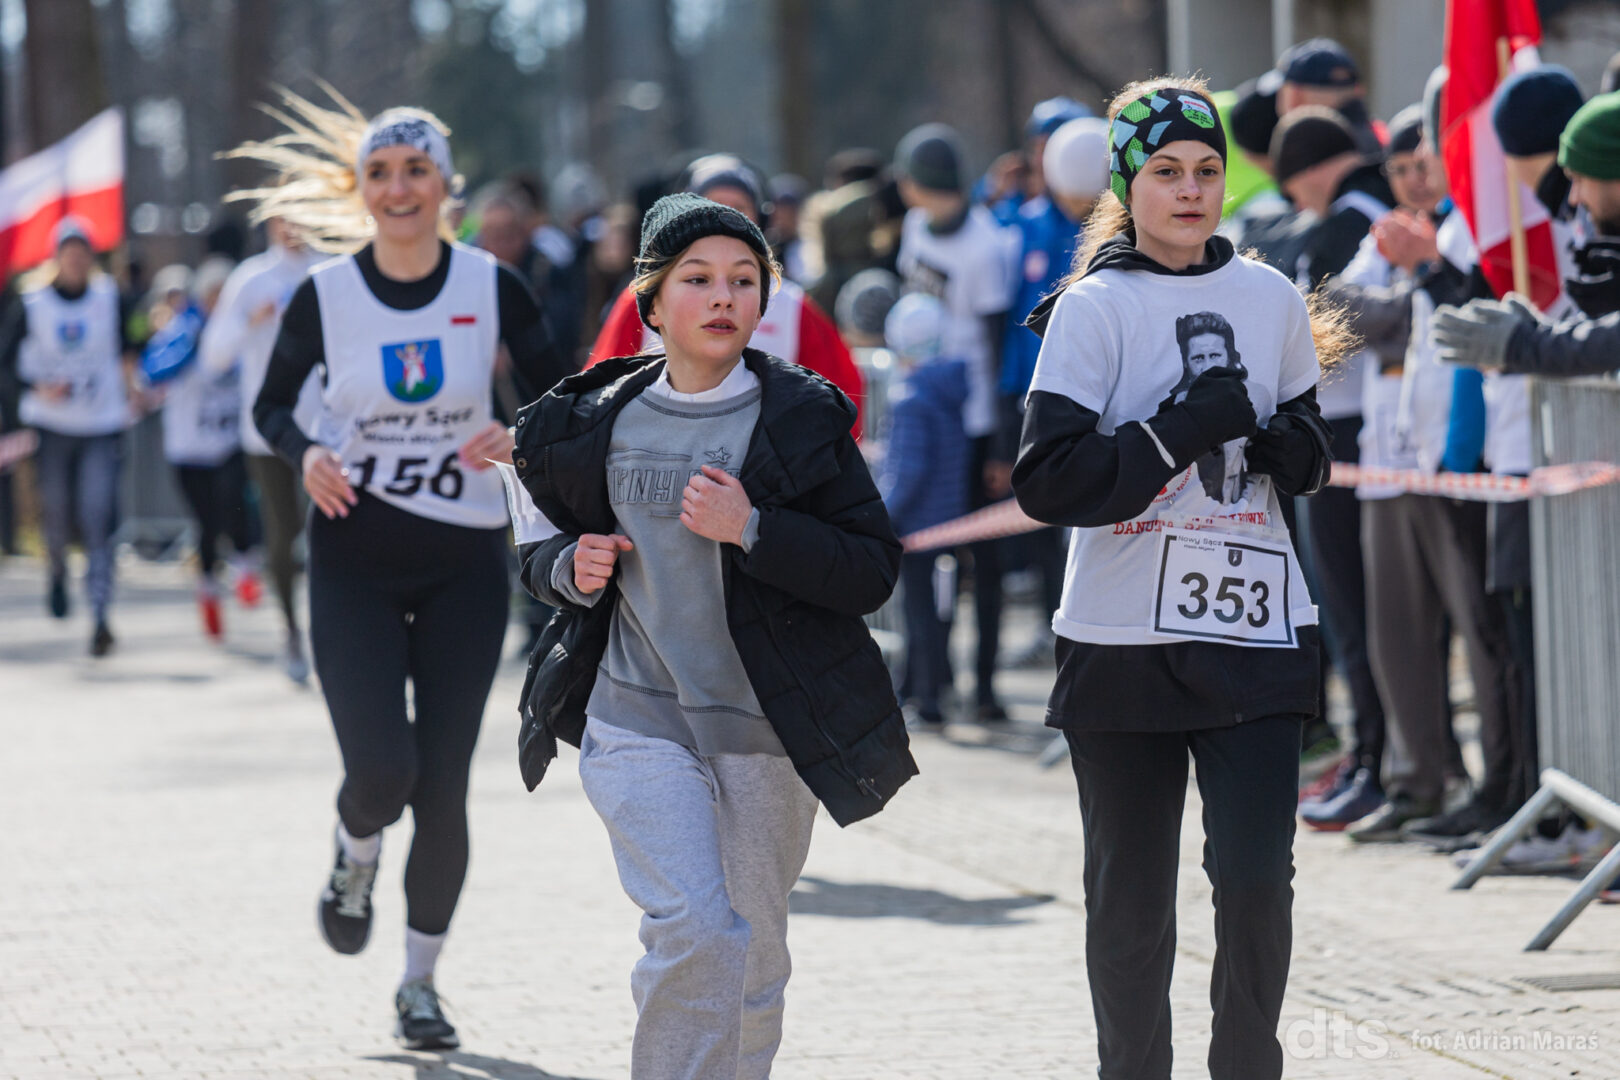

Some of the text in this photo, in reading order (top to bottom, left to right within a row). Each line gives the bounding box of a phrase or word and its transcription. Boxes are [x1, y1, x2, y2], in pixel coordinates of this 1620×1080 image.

[352, 452, 464, 499] 156
[606, 468, 679, 504] KNY
[1178, 535, 1200, 546] Nowy
[1177, 571, 1270, 628] 353
